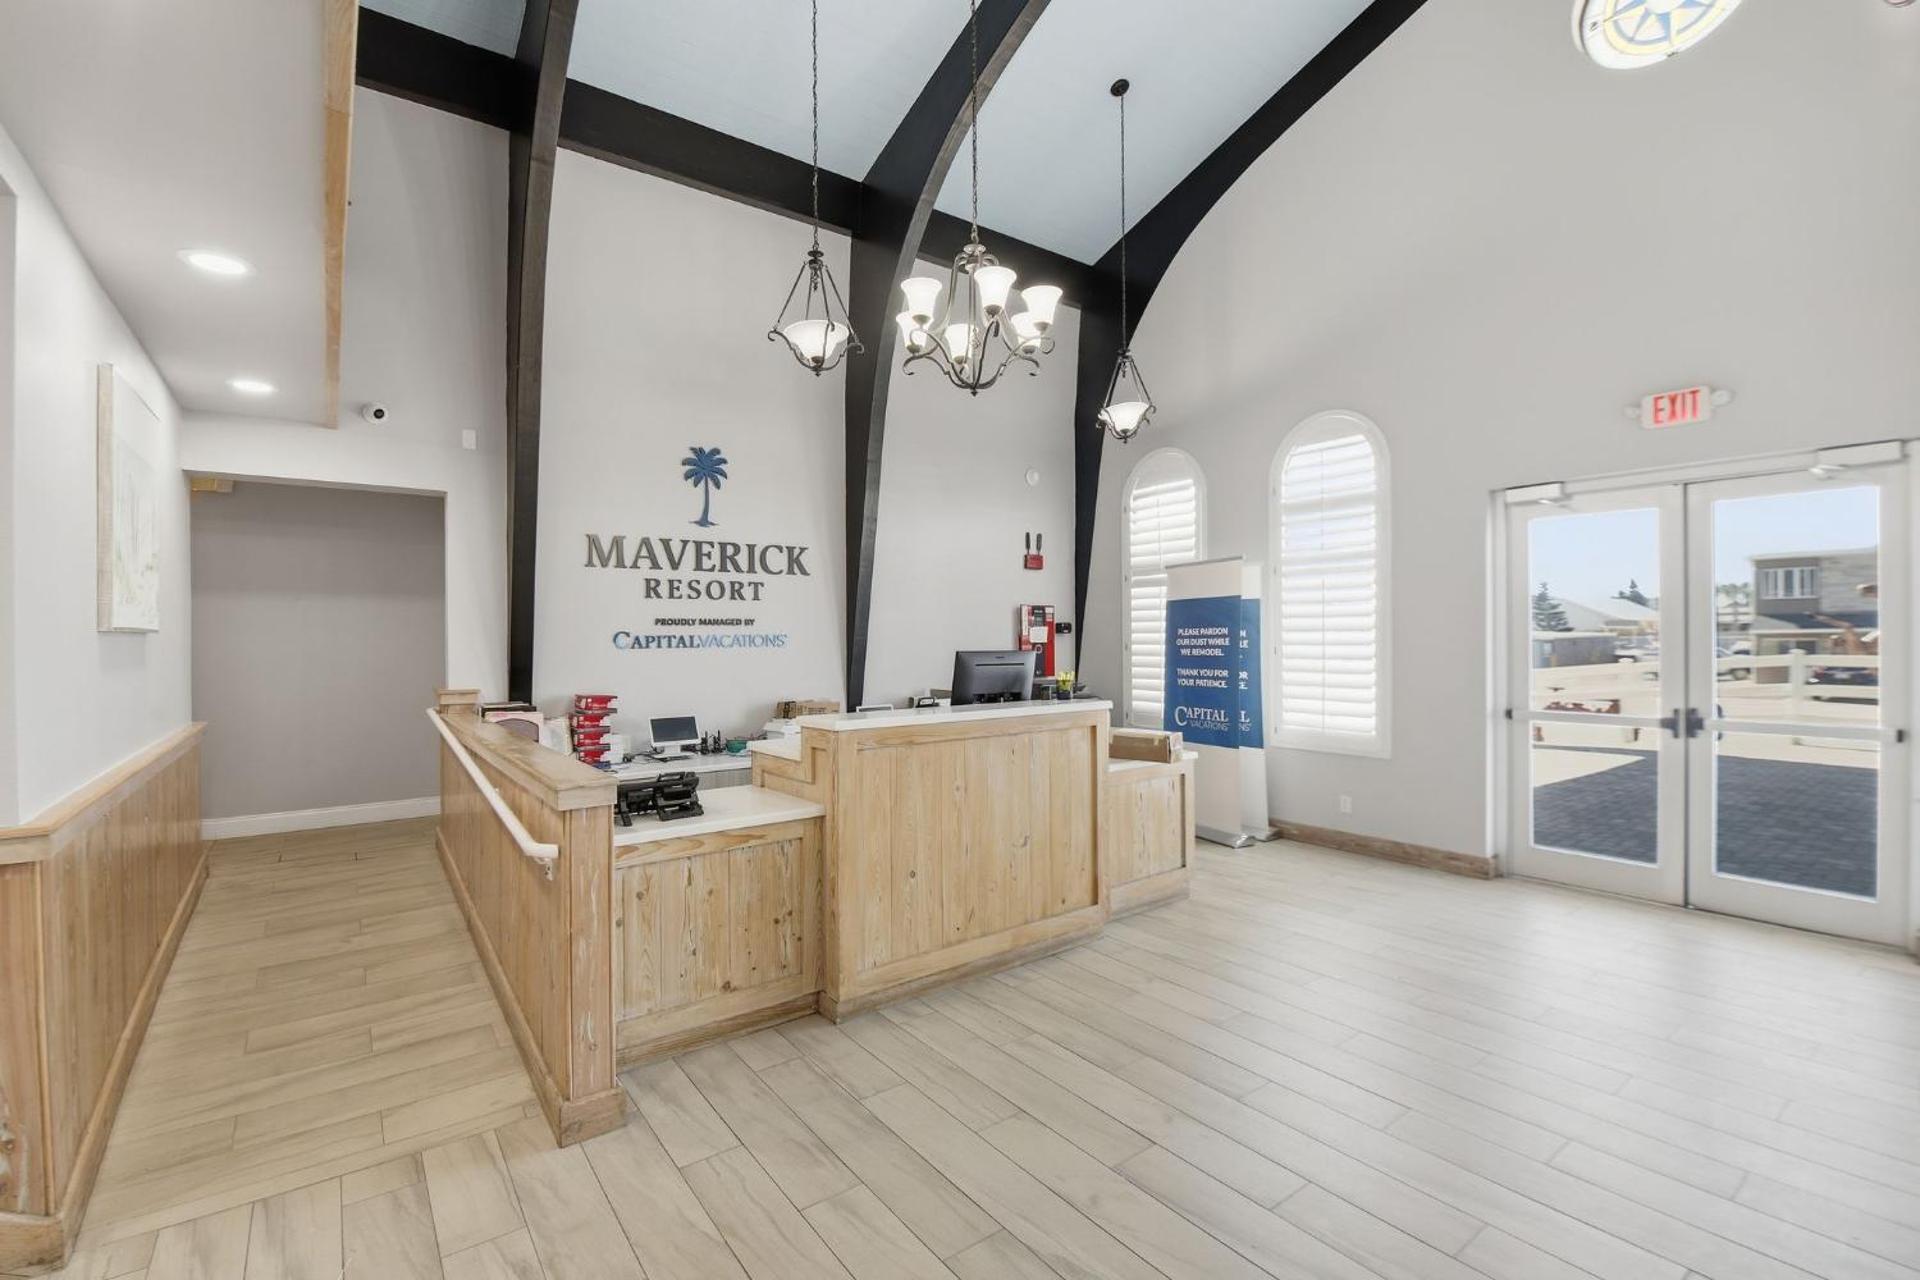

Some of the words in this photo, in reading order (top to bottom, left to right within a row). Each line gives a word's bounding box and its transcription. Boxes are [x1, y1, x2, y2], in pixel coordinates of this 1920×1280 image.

[1653, 388, 1701, 425] EXIT
[584, 533, 810, 576] MAVERICK
[644, 578, 765, 601] RESORT
[655, 617, 696, 626] PROUDLY
[699, 618, 742, 626] MANAGED
[1178, 628, 1200, 636] PLEASE
[1201, 627, 1229, 636] PARDON
[1176, 638, 1190, 646] OUR
[1191, 638, 1207, 646] DUST
[1208, 638, 1230, 646] WHILE
[1180, 648, 1191, 656] WE
[1177, 668, 1199, 676] THANK
[1200, 668, 1214, 677] YOU
[1215, 669, 1229, 677] FOR
[1177, 678, 1194, 687] YOUR
[1174, 705, 1229, 727] CAPITAL
